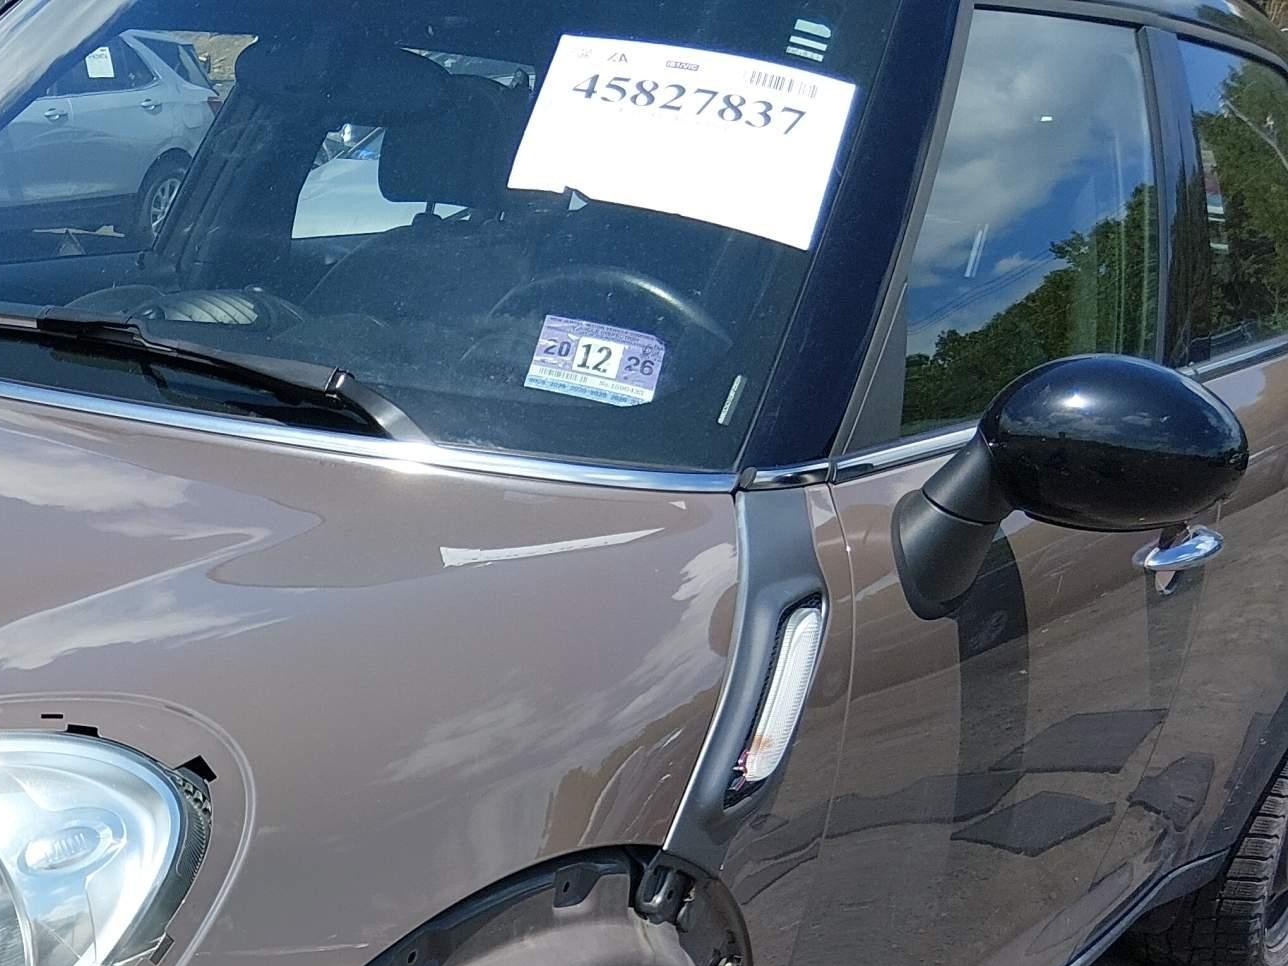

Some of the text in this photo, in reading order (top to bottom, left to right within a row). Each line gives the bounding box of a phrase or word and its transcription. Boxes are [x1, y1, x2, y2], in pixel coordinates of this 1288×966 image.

[572, 73, 807, 135] 45827837
[543, 338, 656, 376] 20 12 26
